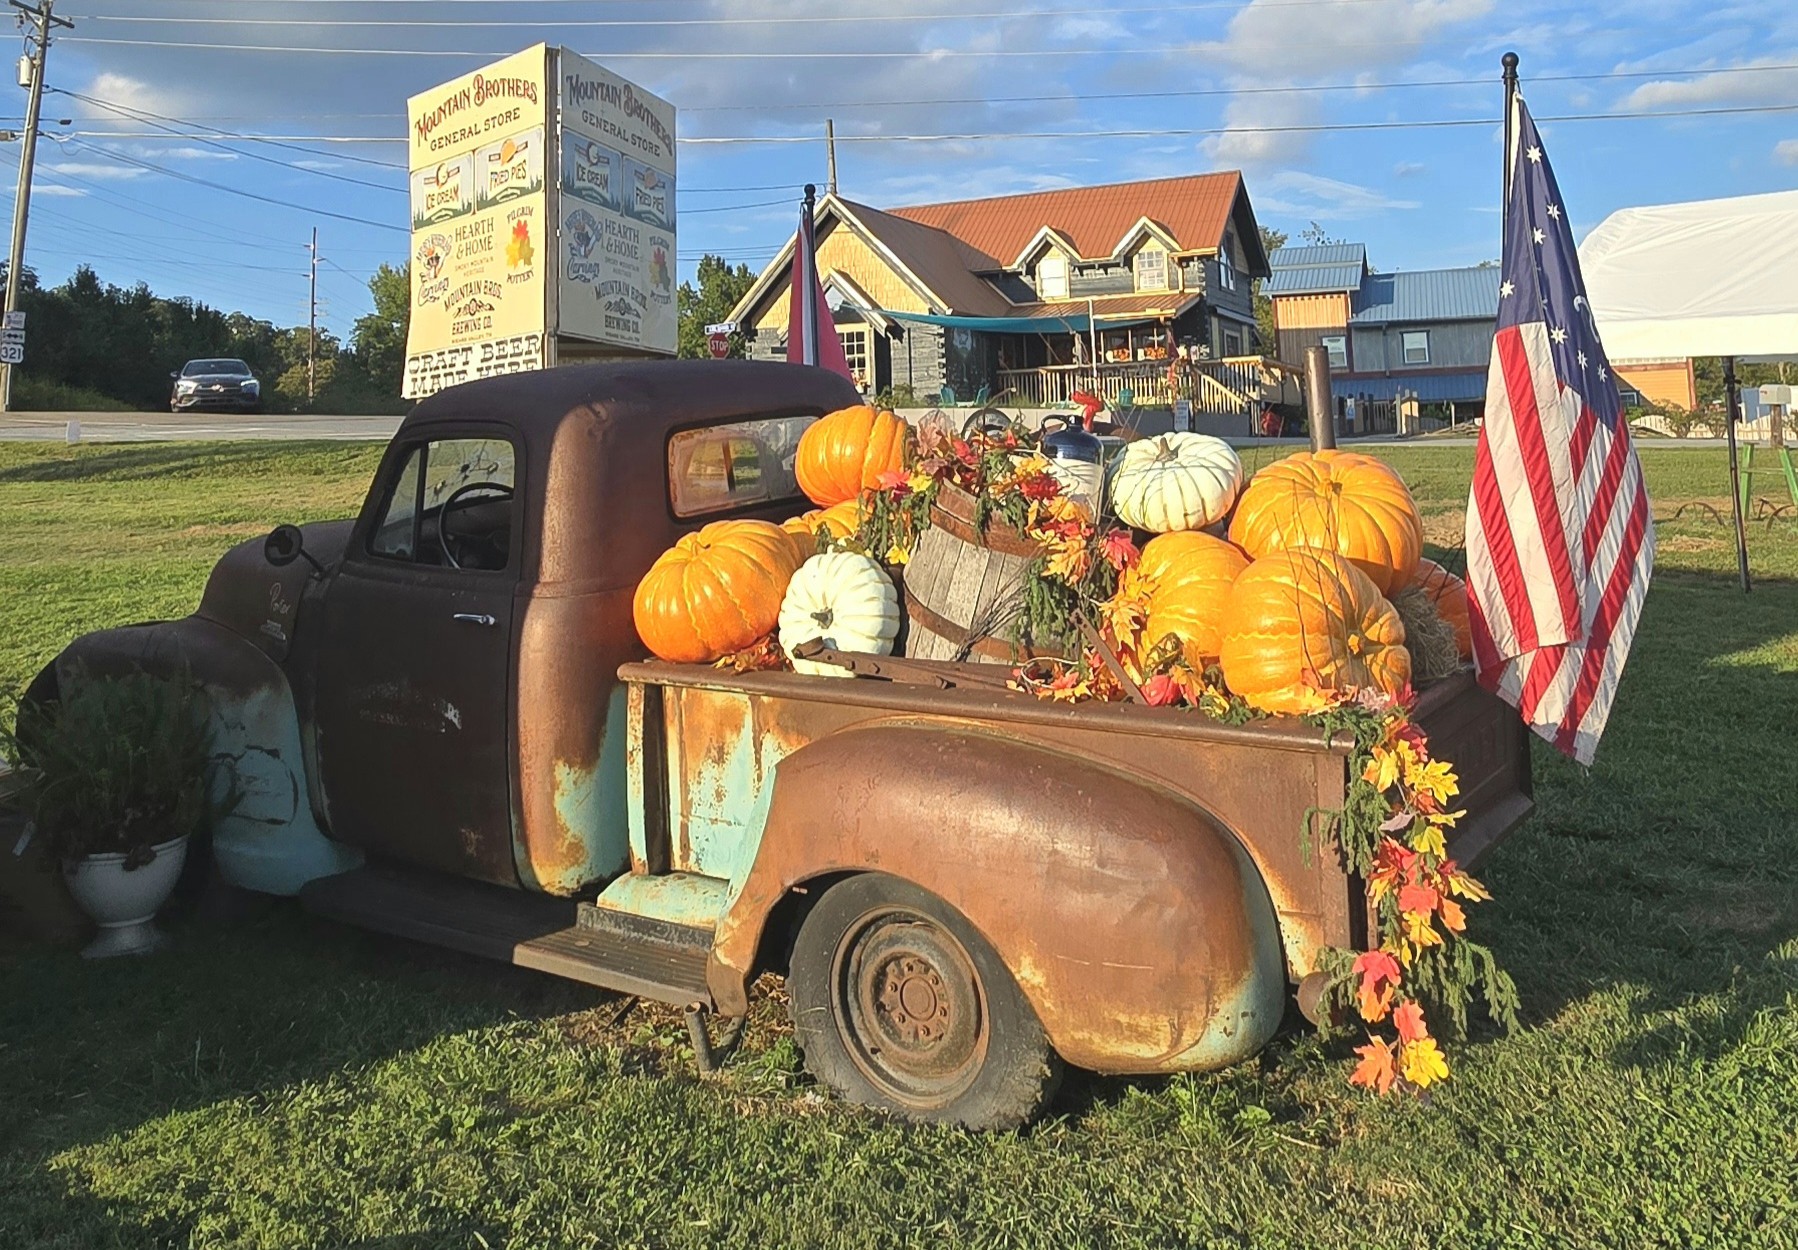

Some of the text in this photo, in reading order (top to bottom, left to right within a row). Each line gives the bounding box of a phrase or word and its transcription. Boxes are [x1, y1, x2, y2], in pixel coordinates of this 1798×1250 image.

[566, 74, 622, 110] MOUNTAIN
[415, 74, 537, 147] MOUNTAIN BROTHERS
[430, 107, 520, 151] GENERAL STORE
[582, 110, 660, 157] GENERAL STORE
[511, 159, 527, 180] PIES
[576, 161, 608, 194] ICE CREAM
[426, 184, 459, 211] ICE CREAM
[455, 217, 494, 242] HEARTH
[605, 218, 639, 243] HEARTH
[507, 267, 534, 284] POTTERY
[444, 280, 482, 312] MOUNTAIN
[594, 280, 630, 300] MOUNTAIN
[452, 317, 481, 335] BREWING
[605, 315, 631, 332] BREWING
[1, 347, 21, 360] 321
[408, 334, 540, 374] CRAFT BEER
[711, 340, 728, 351] STOP
